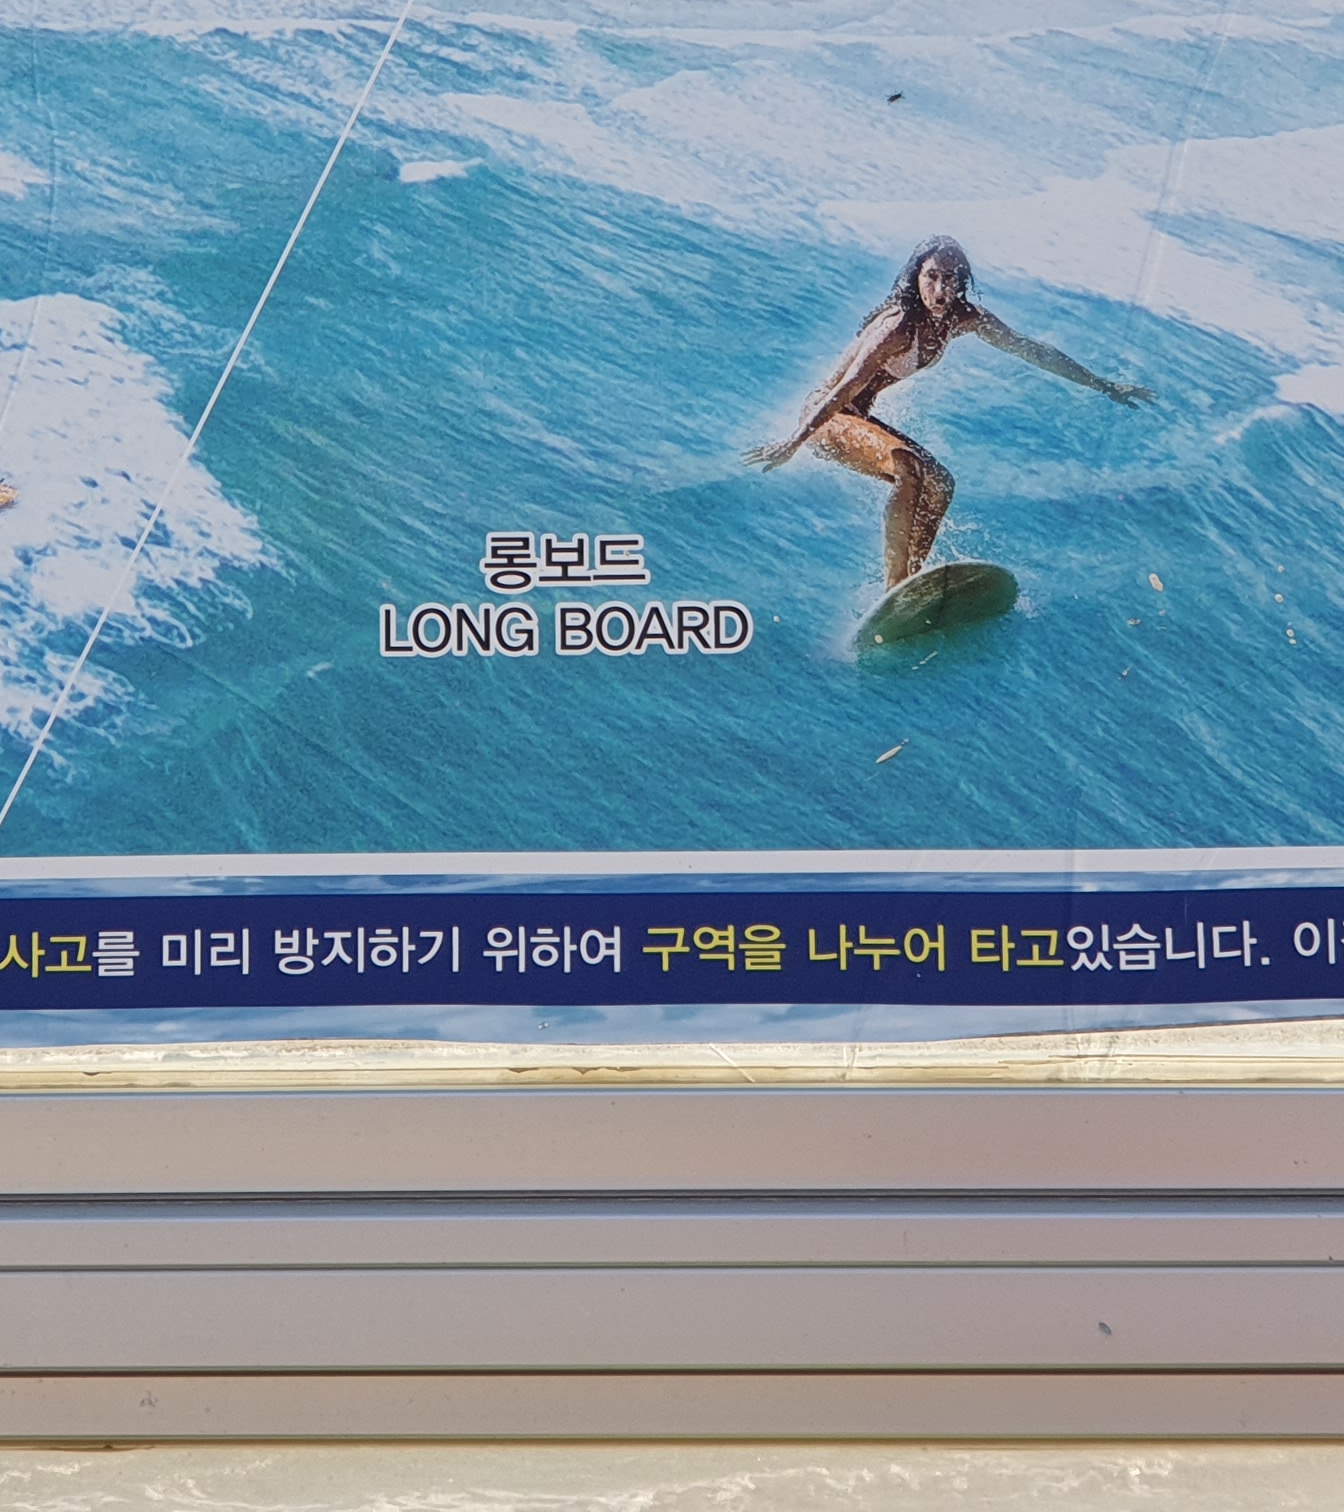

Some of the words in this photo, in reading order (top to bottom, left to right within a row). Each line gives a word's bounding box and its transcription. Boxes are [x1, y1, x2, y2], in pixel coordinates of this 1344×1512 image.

[483, 536, 647, 590] 롱보드
[382, 605, 536, 654] LONG
[558, 602, 749, 652] BOARD
[160, 927, 250, 976] 미리
[272, 924, 462, 976] 방지하기
[482, 925, 623, 974] 위하여
[640, 922, 786, 974] 구역을
[807, 920, 948, 974] 나누어
[969, 918, 1271, 974] 타고있습니다.
